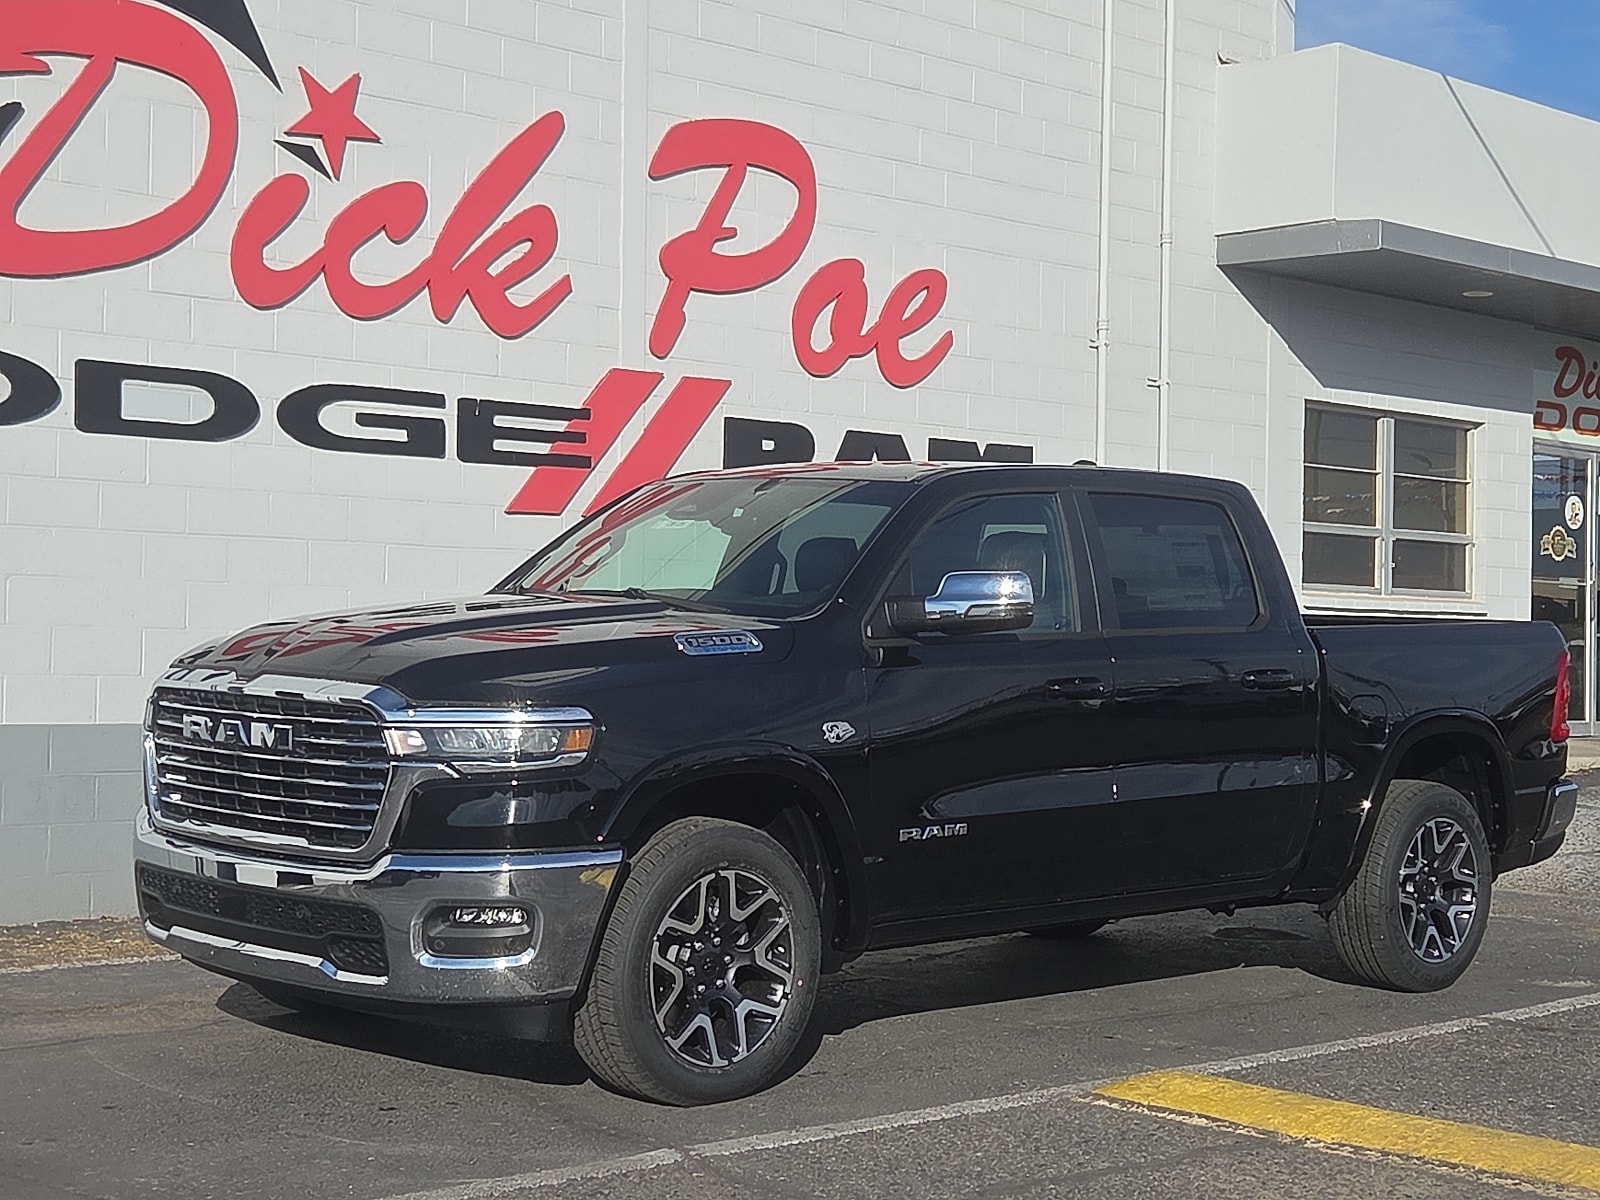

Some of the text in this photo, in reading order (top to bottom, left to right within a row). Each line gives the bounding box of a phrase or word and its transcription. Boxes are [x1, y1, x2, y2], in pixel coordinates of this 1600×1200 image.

[0, 0, 954, 389] Dick Poe
[1553, 345, 1600, 400] Di
[685, 634, 748, 648] 1500
[182, 713, 293, 751] RAM
[899, 823, 968, 841] RAM
